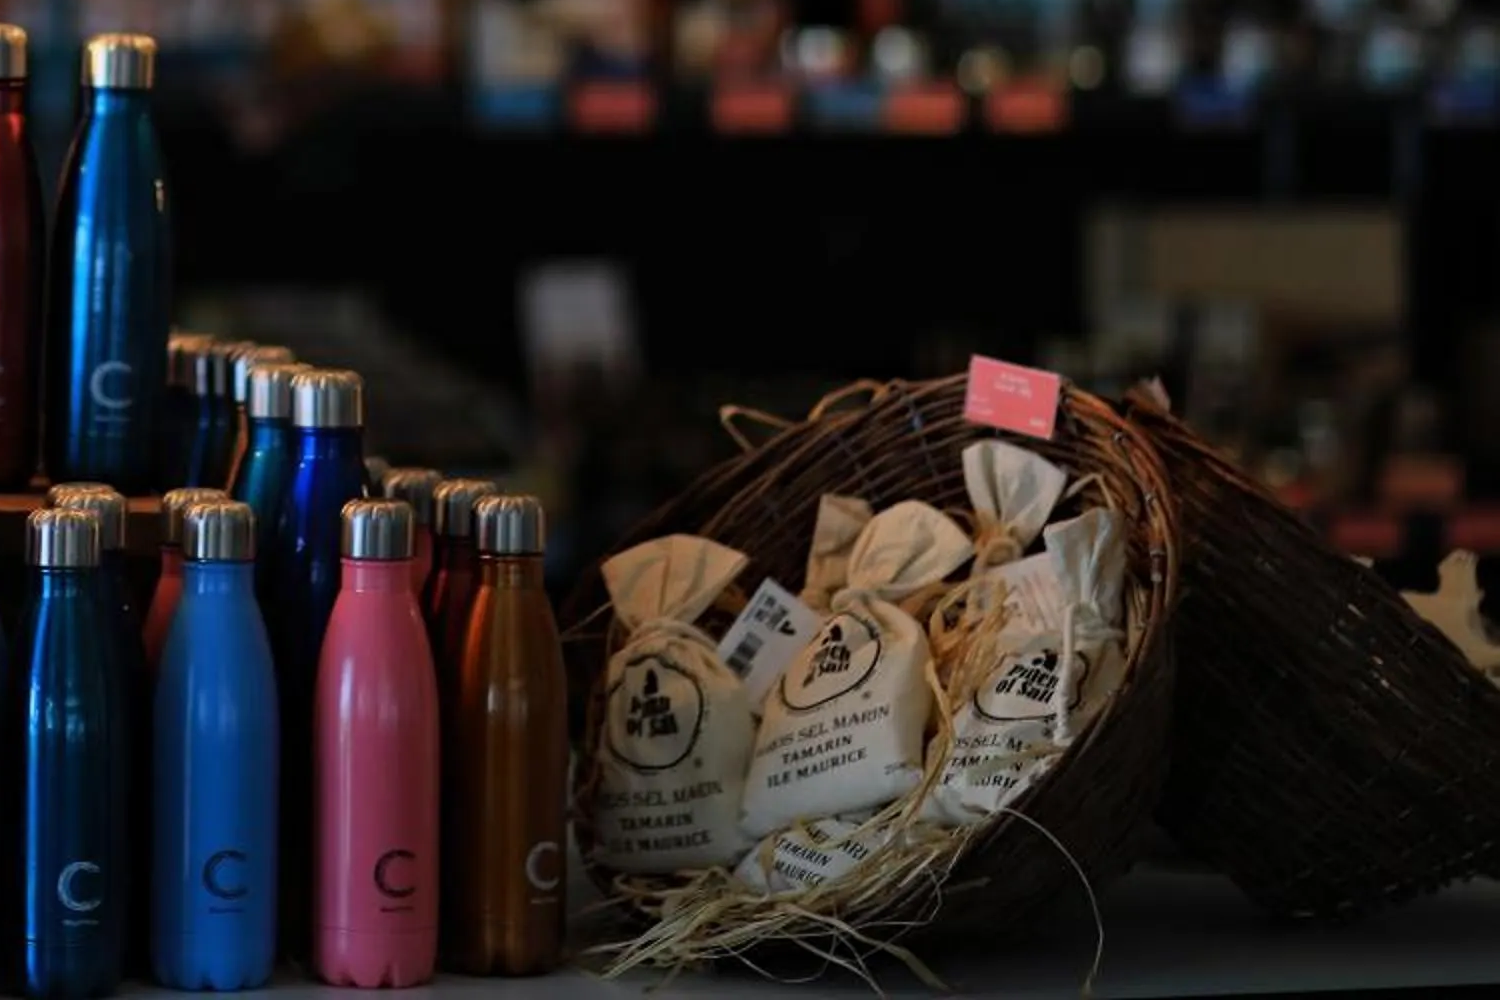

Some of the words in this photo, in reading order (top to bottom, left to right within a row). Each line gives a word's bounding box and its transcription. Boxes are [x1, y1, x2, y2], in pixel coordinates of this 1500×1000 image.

[90, 360, 132, 409] C
[833, 704, 890, 729] MARIN
[767, 772, 792, 789] ILE
[796, 747, 867, 778] MAURICE
[782, 735, 852, 765] TAMARIN
[618, 813, 693, 831] TAMARIN
[57, 861, 101, 911] C
[203, 850, 247, 899] C
[374, 849, 416, 898] C
[526, 841, 559, 890] C
